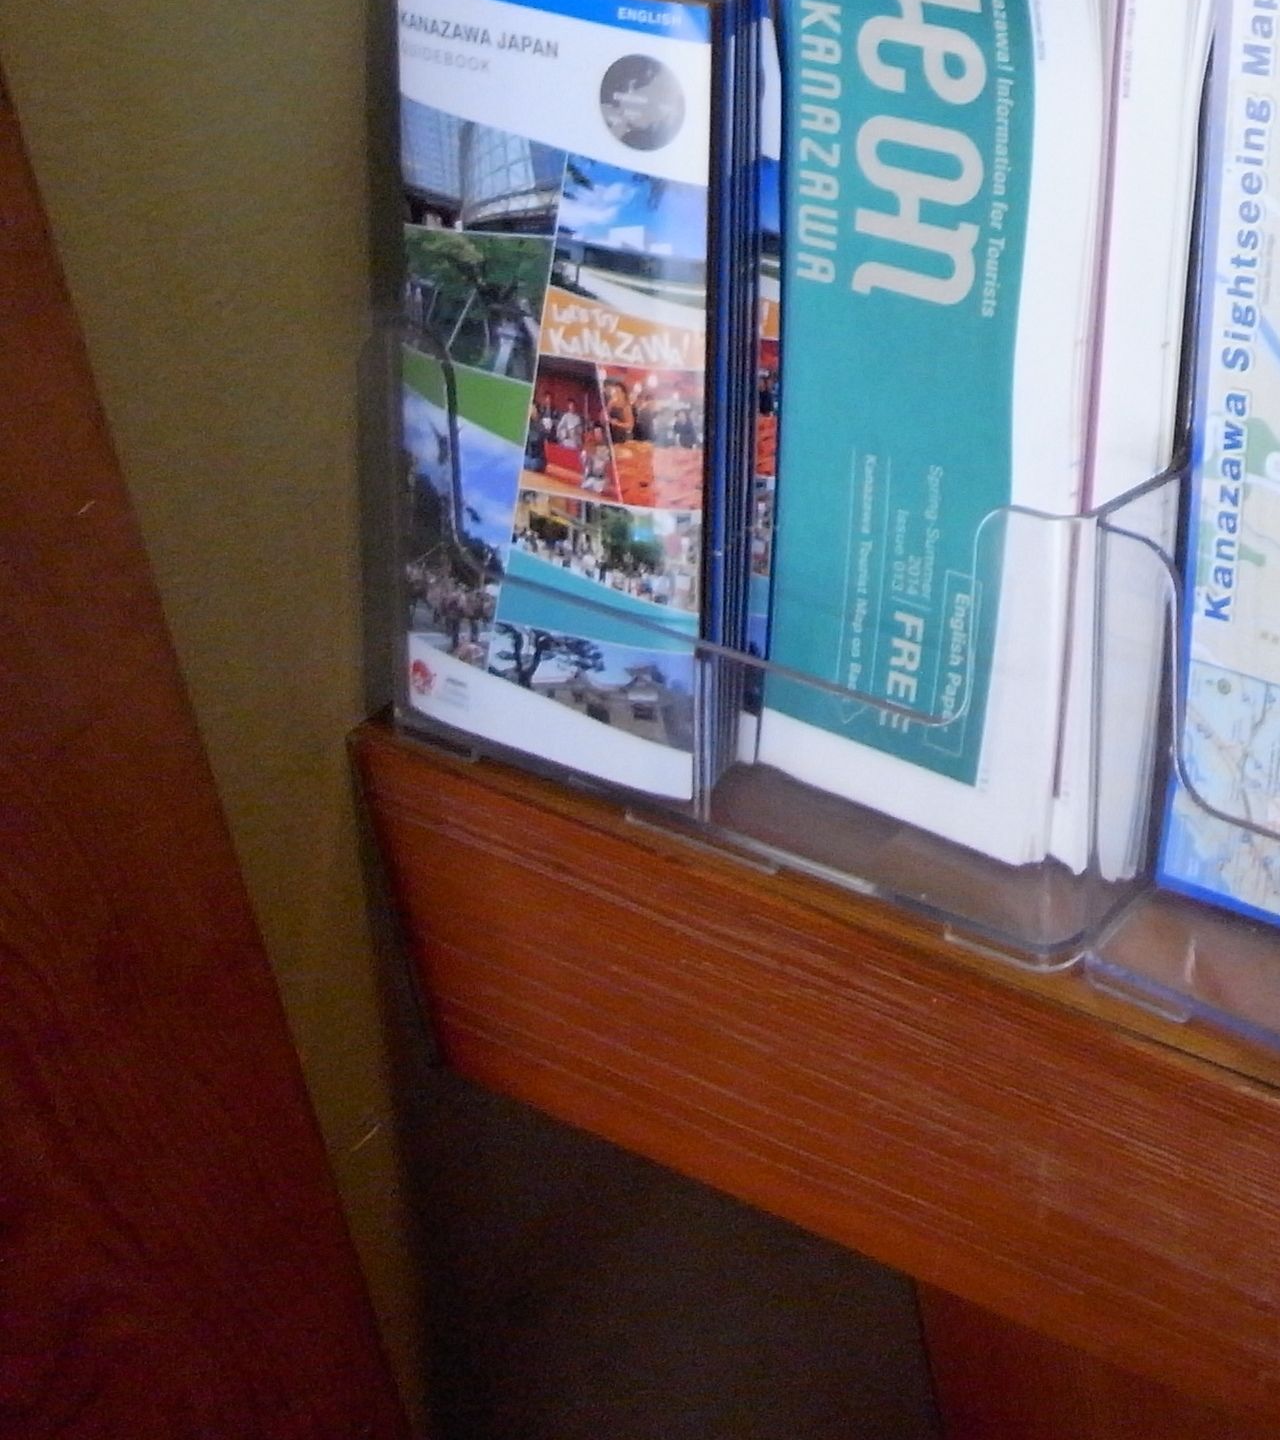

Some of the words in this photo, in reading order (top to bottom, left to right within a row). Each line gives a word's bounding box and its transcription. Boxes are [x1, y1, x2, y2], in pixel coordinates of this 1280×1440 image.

[496, 30, 560, 59] JAPAN
[616, 6, 682, 27] ENGLISH
[992, 78, 1015, 196] Information
[990, 201, 1009, 231] for
[1221, 96, 1273, 373] Sightseeing
[981, 237, 1006, 318] Tourists
[1204, 390, 1248, 622] Kanazawa
[948, 592, 970, 667] English
